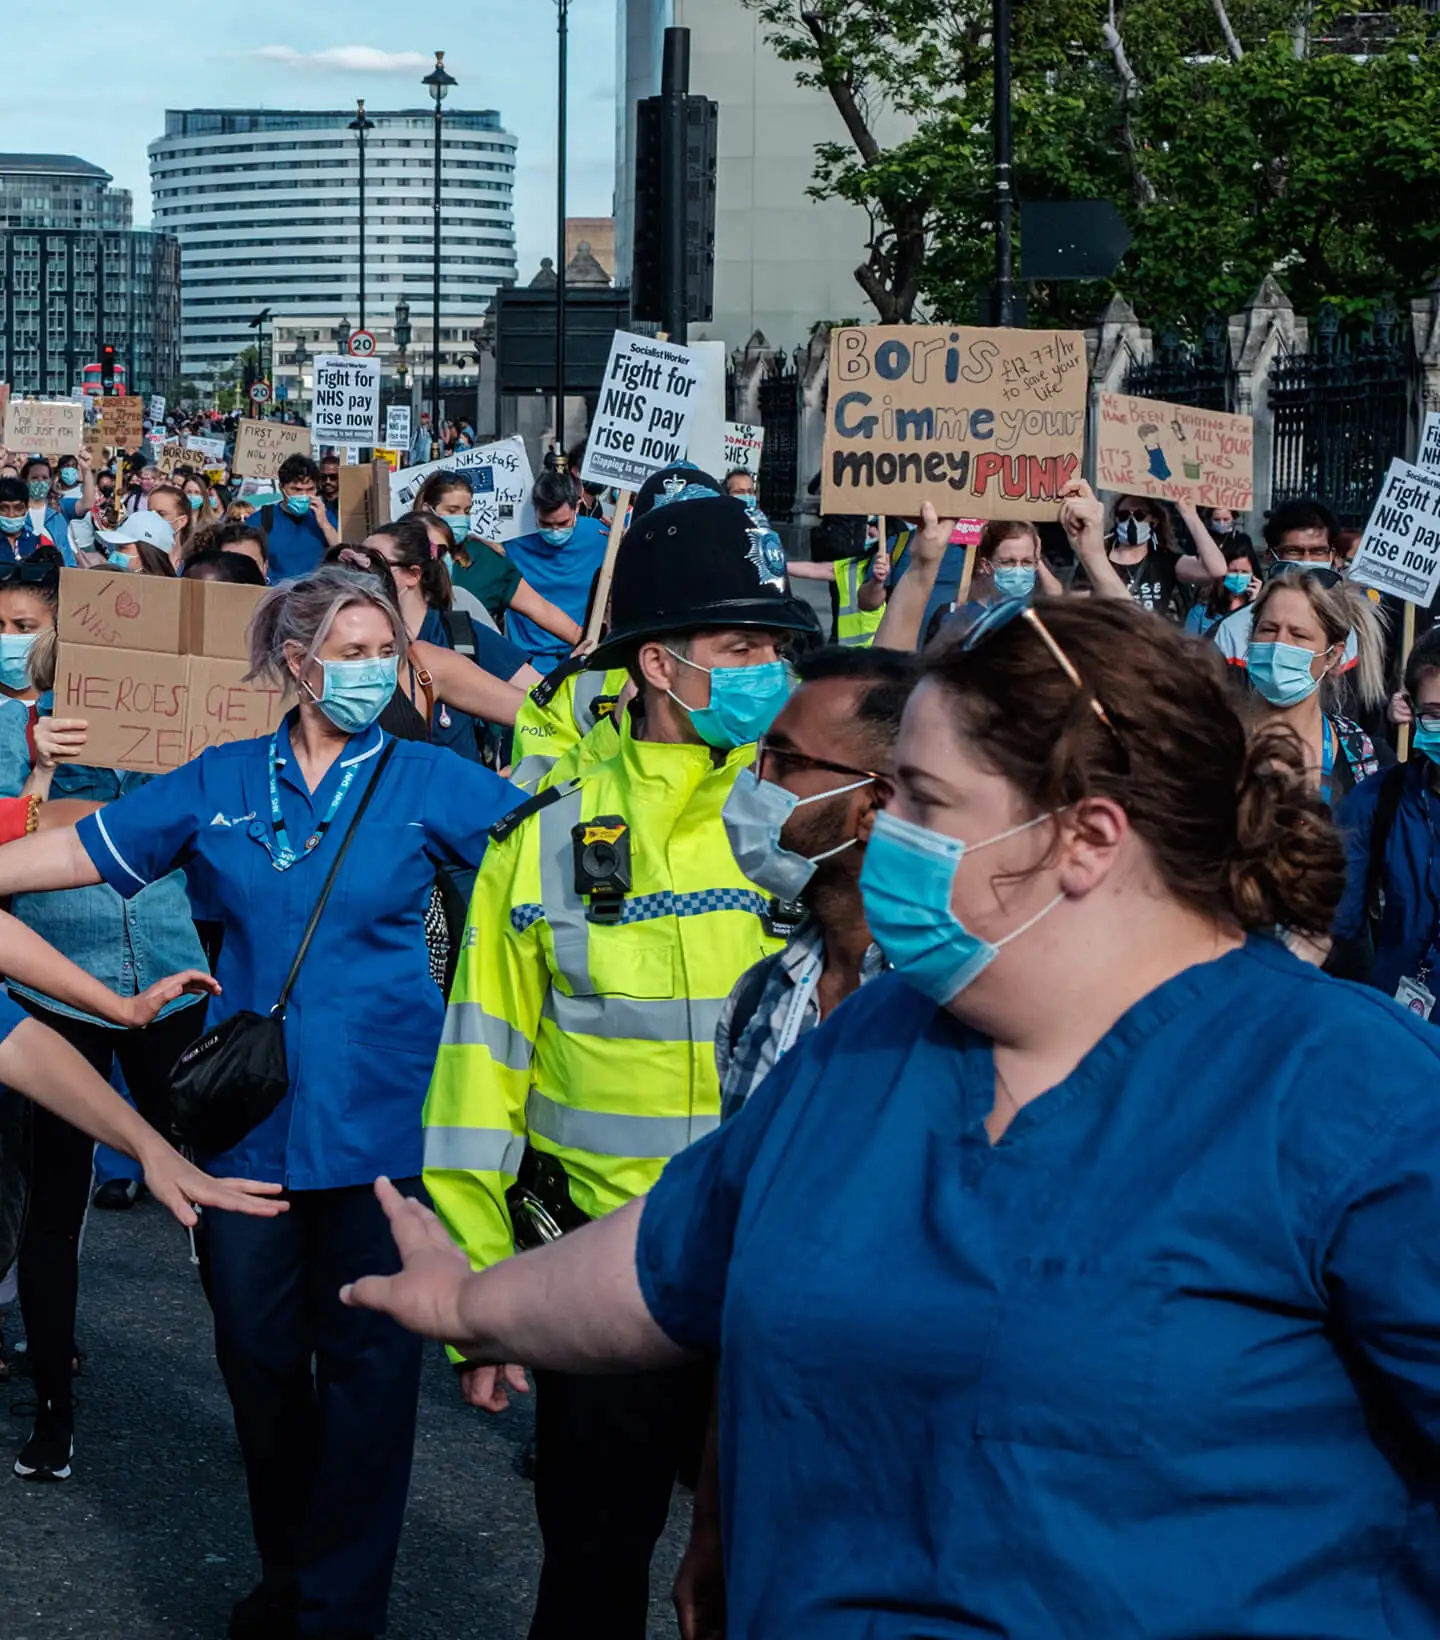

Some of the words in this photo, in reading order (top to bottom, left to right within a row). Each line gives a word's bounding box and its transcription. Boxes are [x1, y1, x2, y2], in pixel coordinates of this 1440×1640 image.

[353, 339, 371, 350] 20
[836, 329, 1000, 384] Boris
[317, 369, 350, 389] Fight
[355, 370, 374, 387] for
[611, 353, 662, 391] Fight
[666, 367, 697, 397] for
[252, 388, 268, 397] 20
[316, 390, 344, 407] NHS
[349, 395, 372, 411] pay
[316, 409, 342, 424] rise
[346, 414, 373, 426] now
[602, 388, 647, 422] NHS
[648, 406, 685, 437] pay
[834, 391, 995, 442] Gimme
[995, 409, 1083, 451] your
[244, 426, 273, 439] FIRST
[280, 430, 297, 442] YOU
[594, 421, 635, 453] rise
[640, 437, 680, 462] now
[1193, 429, 1213, 442] ALL
[1216, 432, 1251, 456] YOUR
[161, 457, 171, 470] A
[163, 446, 191, 461] BORIS
[193, 450, 204, 463] IS
[247, 449, 267, 459] NOW
[456, 452, 483, 467] NHS
[486, 451, 520, 472] staff
[832, 450, 970, 490] money
[970, 451, 1079, 502] PUNK
[1197, 484, 1251, 509] RIGHT
[1386, 476, 1430, 512] Fight
[1375, 504, 1414, 537] NHS
[1365, 532, 1399, 561] rise
[1402, 549, 1438, 576] now
[67, 672, 187, 717] HEROES
[205, 684, 281, 728] GET
